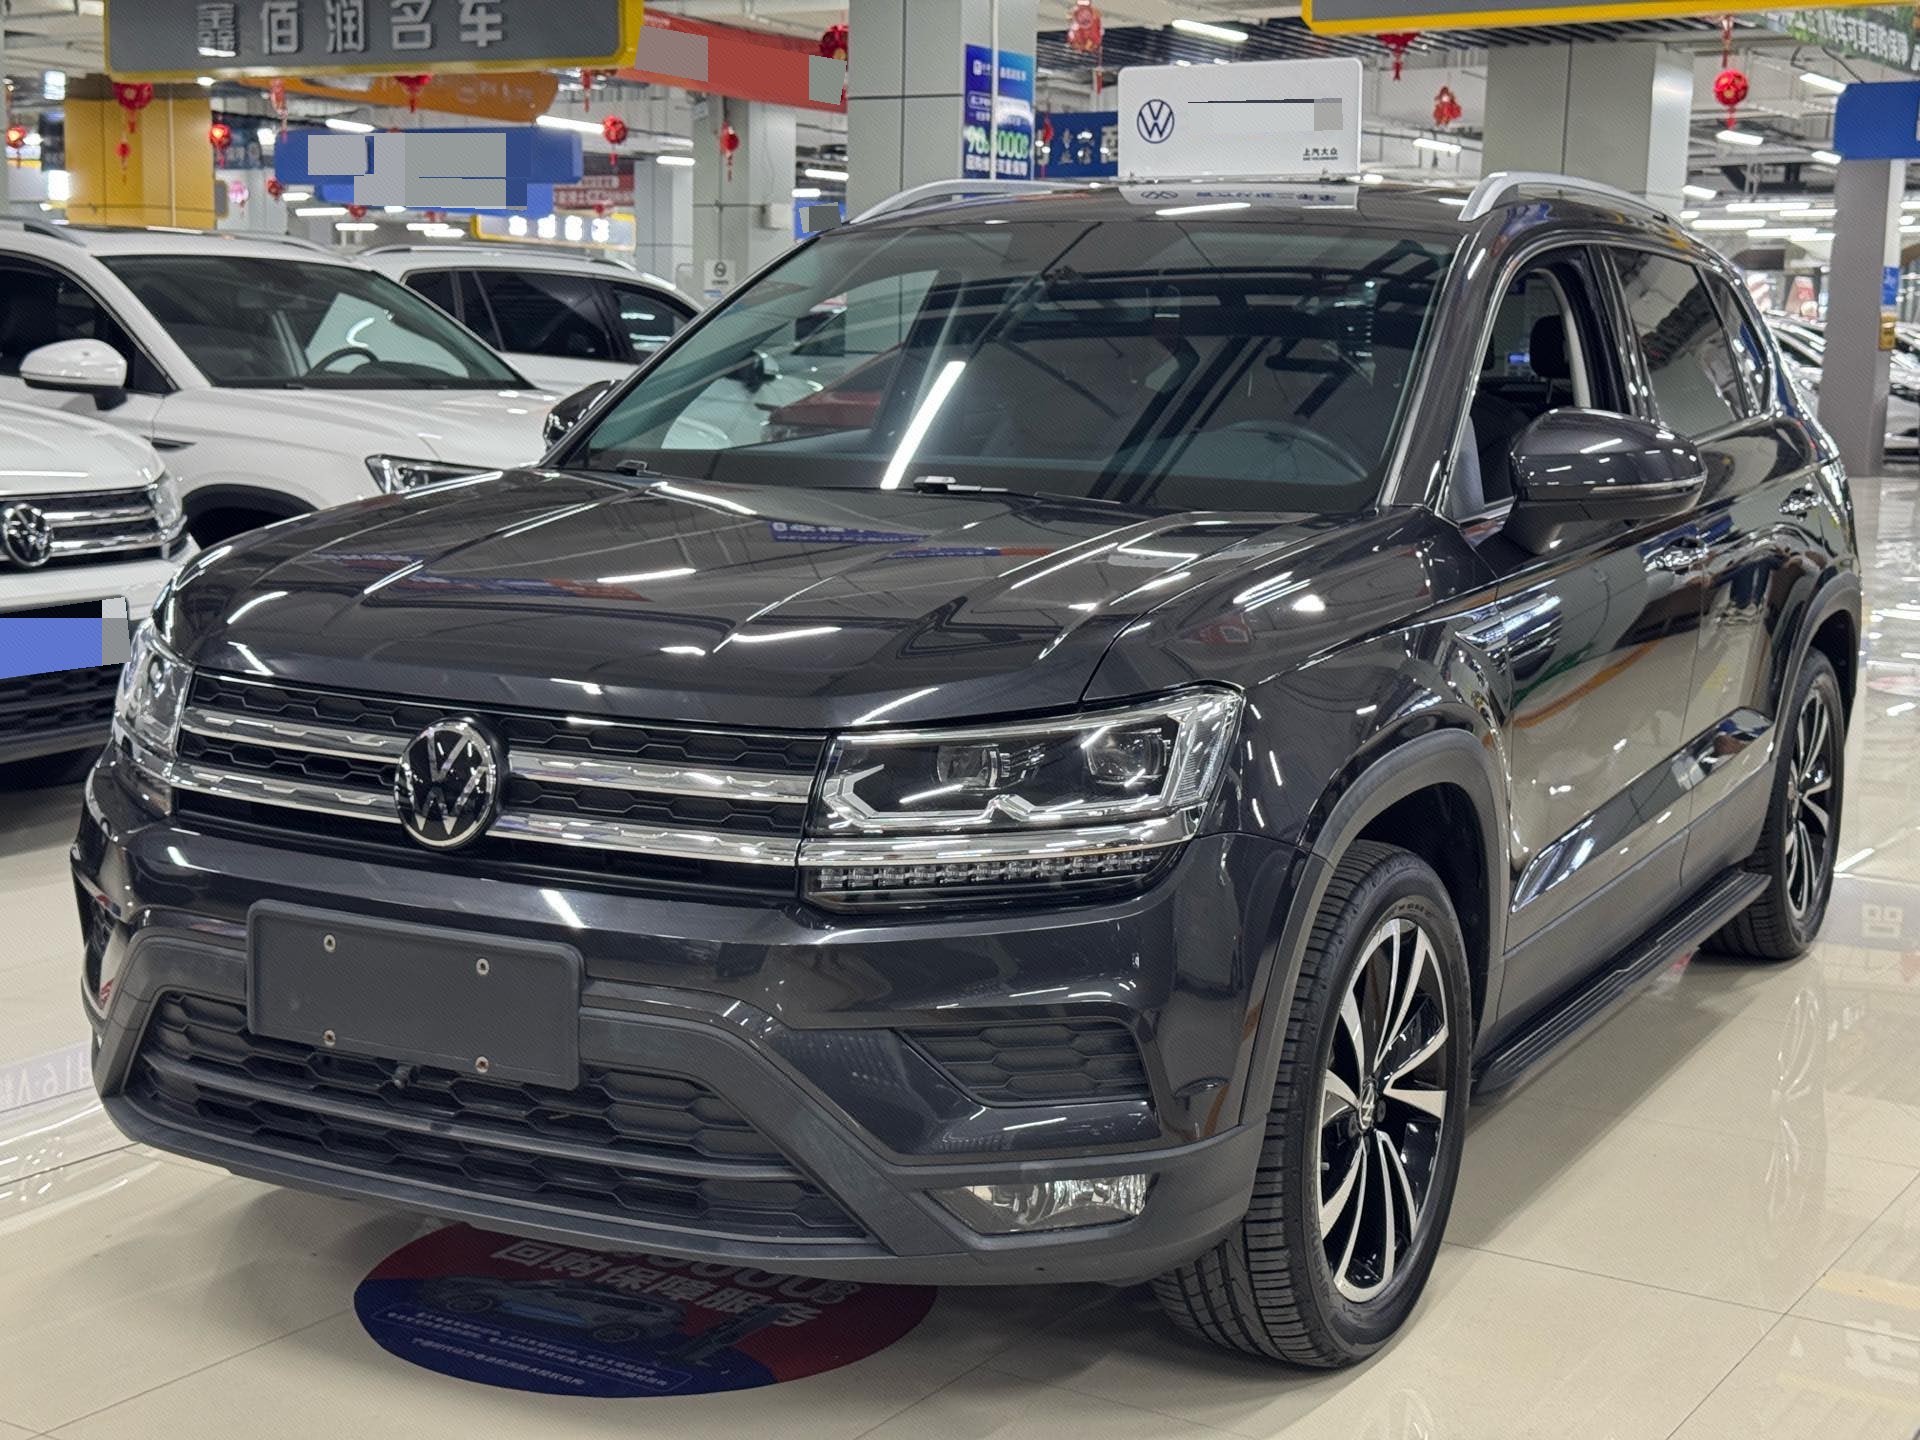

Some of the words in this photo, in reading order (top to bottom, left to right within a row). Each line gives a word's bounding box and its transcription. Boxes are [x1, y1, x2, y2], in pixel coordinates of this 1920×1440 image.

[199, 0, 502, 56] 鑫佰润名车
